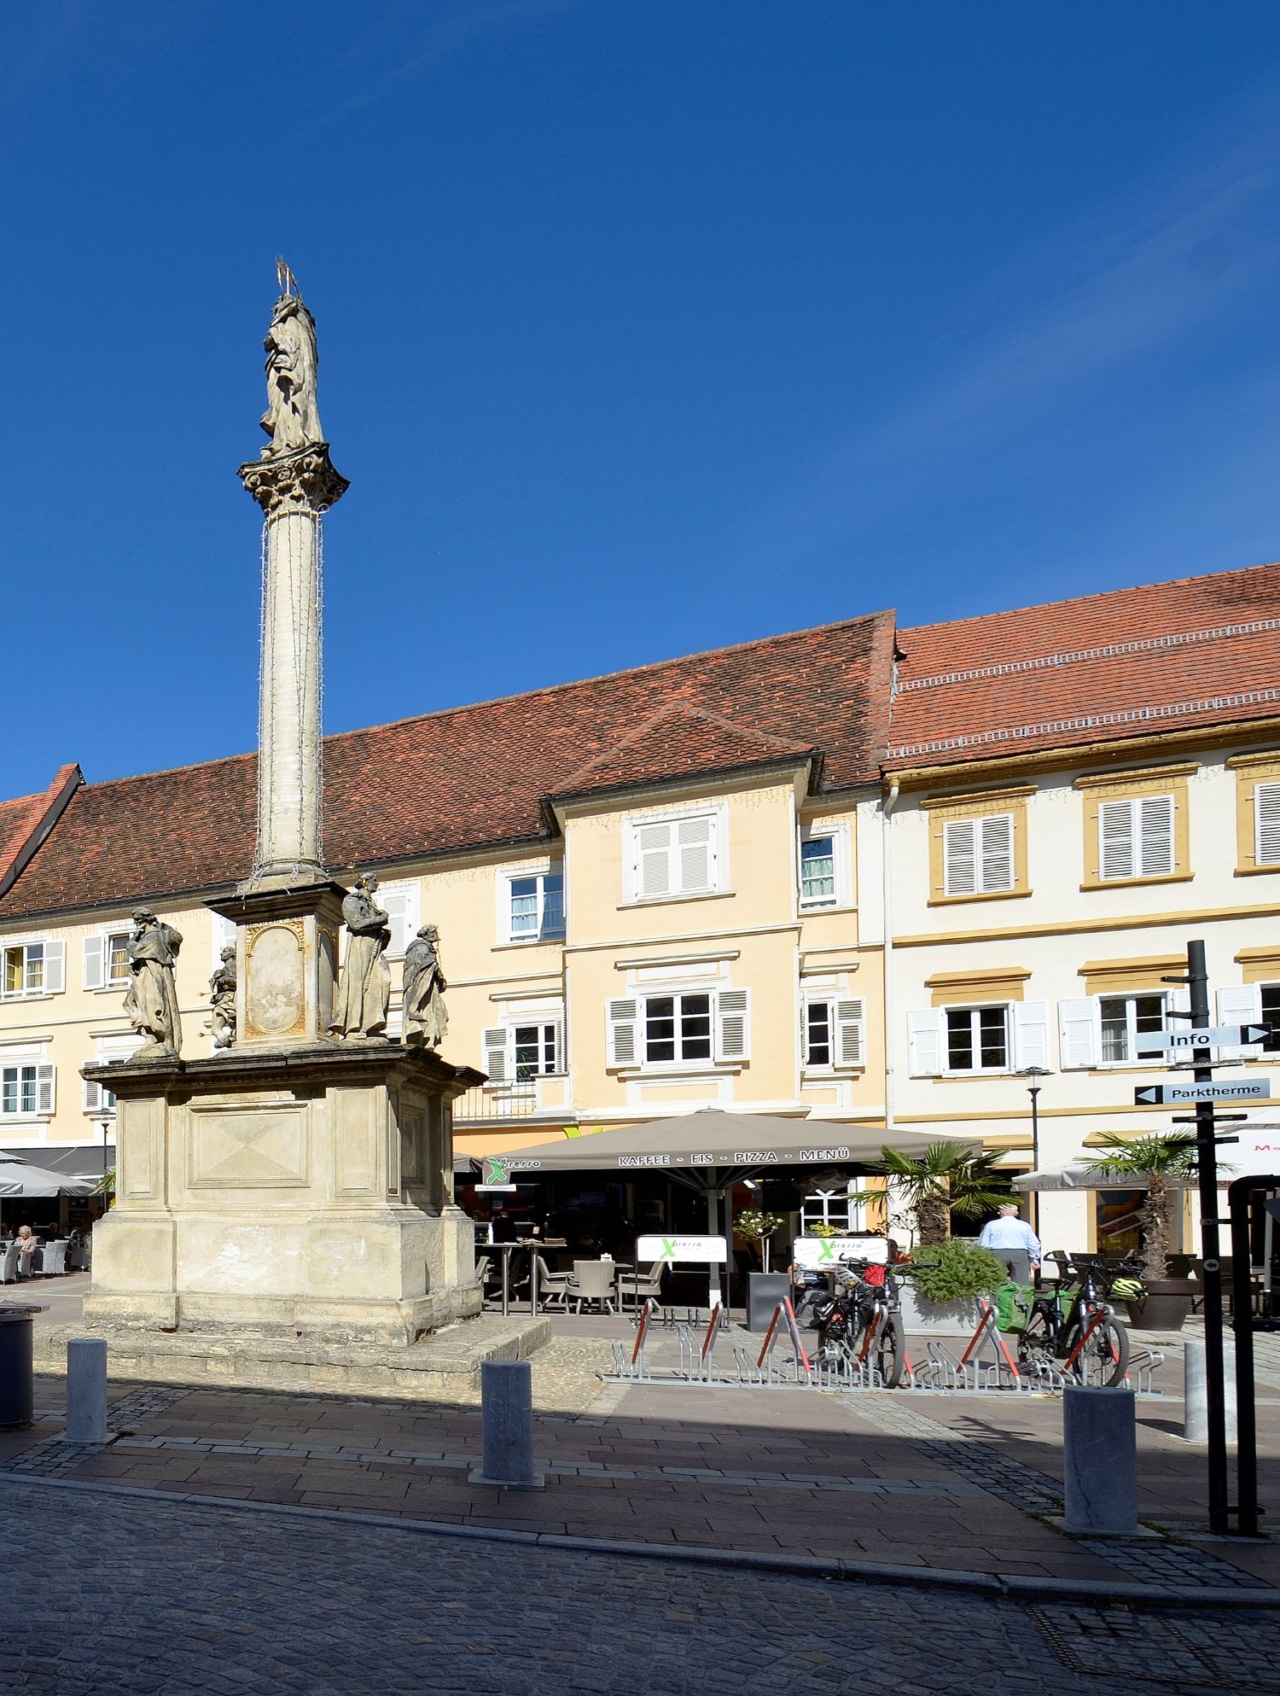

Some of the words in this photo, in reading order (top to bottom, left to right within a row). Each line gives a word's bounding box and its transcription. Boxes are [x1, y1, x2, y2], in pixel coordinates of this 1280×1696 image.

[1170, 1033, 1210, 1047] Info
[1172, 1085, 1261, 1098] Parktherme
[618, 1154, 671, 1167] KAFFEE
[690, 1153, 714, 1165] EIS
[734, 1150, 778, 1163] PIZZA
[799, 1146, 850, 1161] MENÜ
